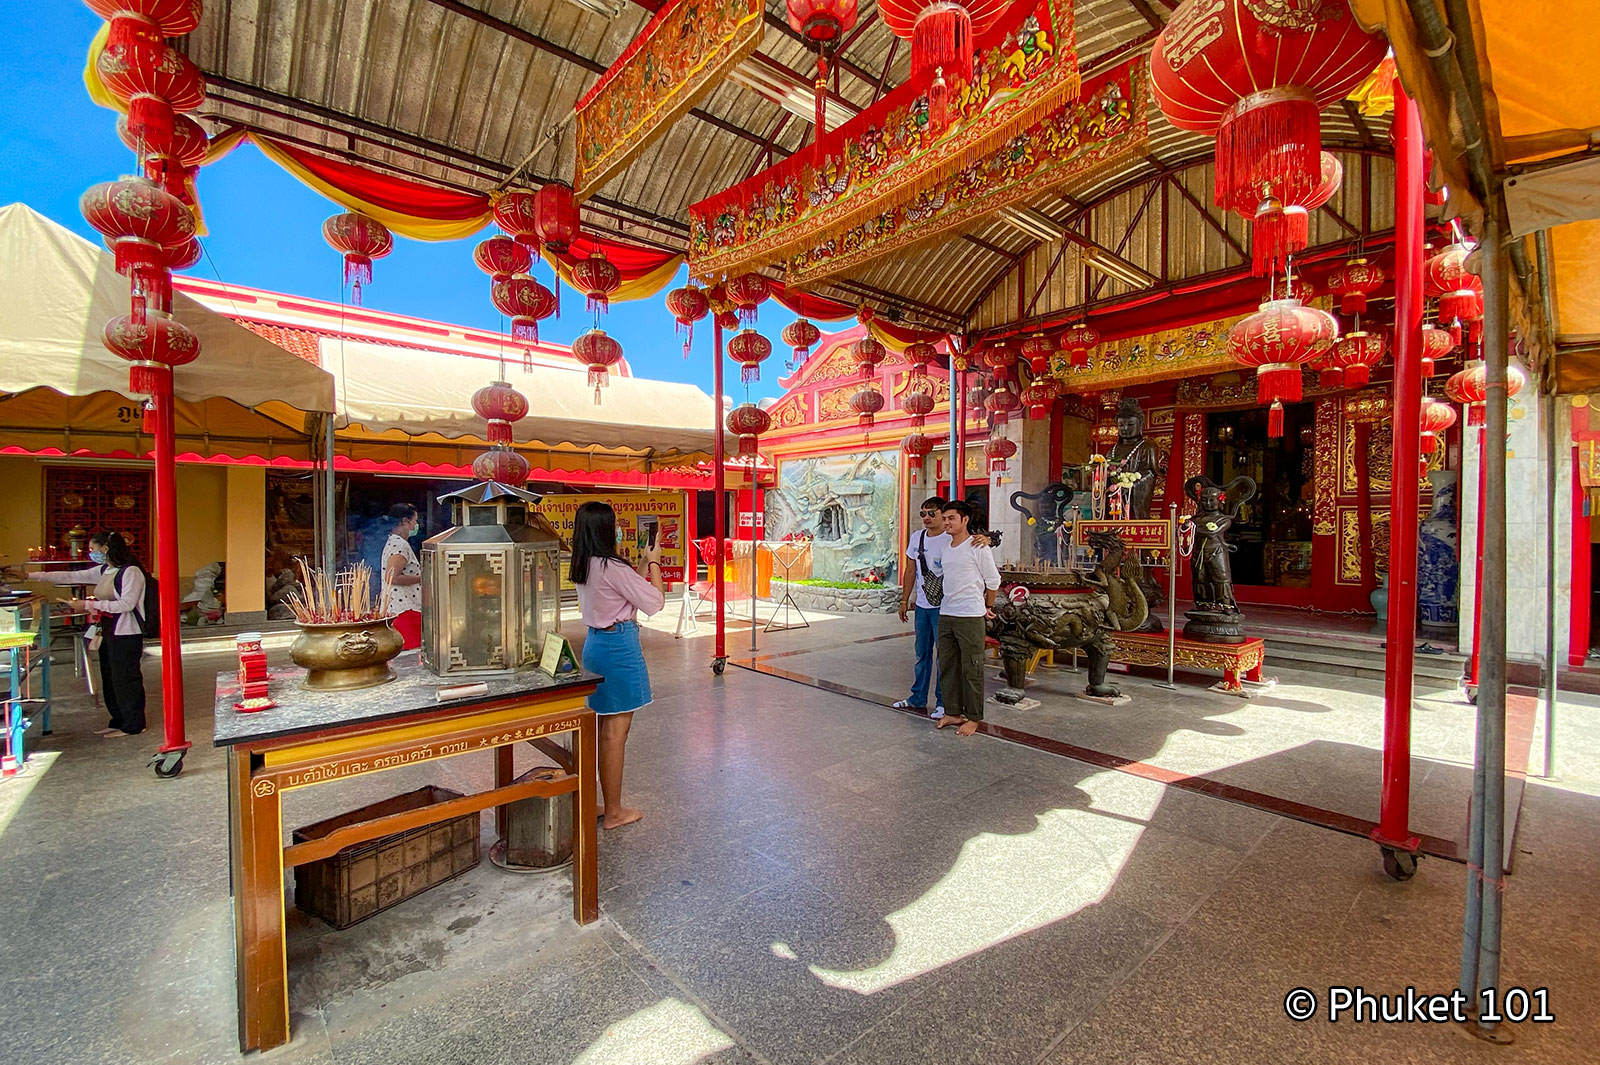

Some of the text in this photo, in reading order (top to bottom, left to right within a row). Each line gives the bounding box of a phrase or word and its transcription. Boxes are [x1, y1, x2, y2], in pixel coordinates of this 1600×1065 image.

[1013, 588, 1026, 602] 2
[341, 761, 369, 775] และ
[373, 744, 433, 768] ครอบครัว
[440, 741, 468, 755] ถวาย
[549, 718, 581, 732] (2543)
